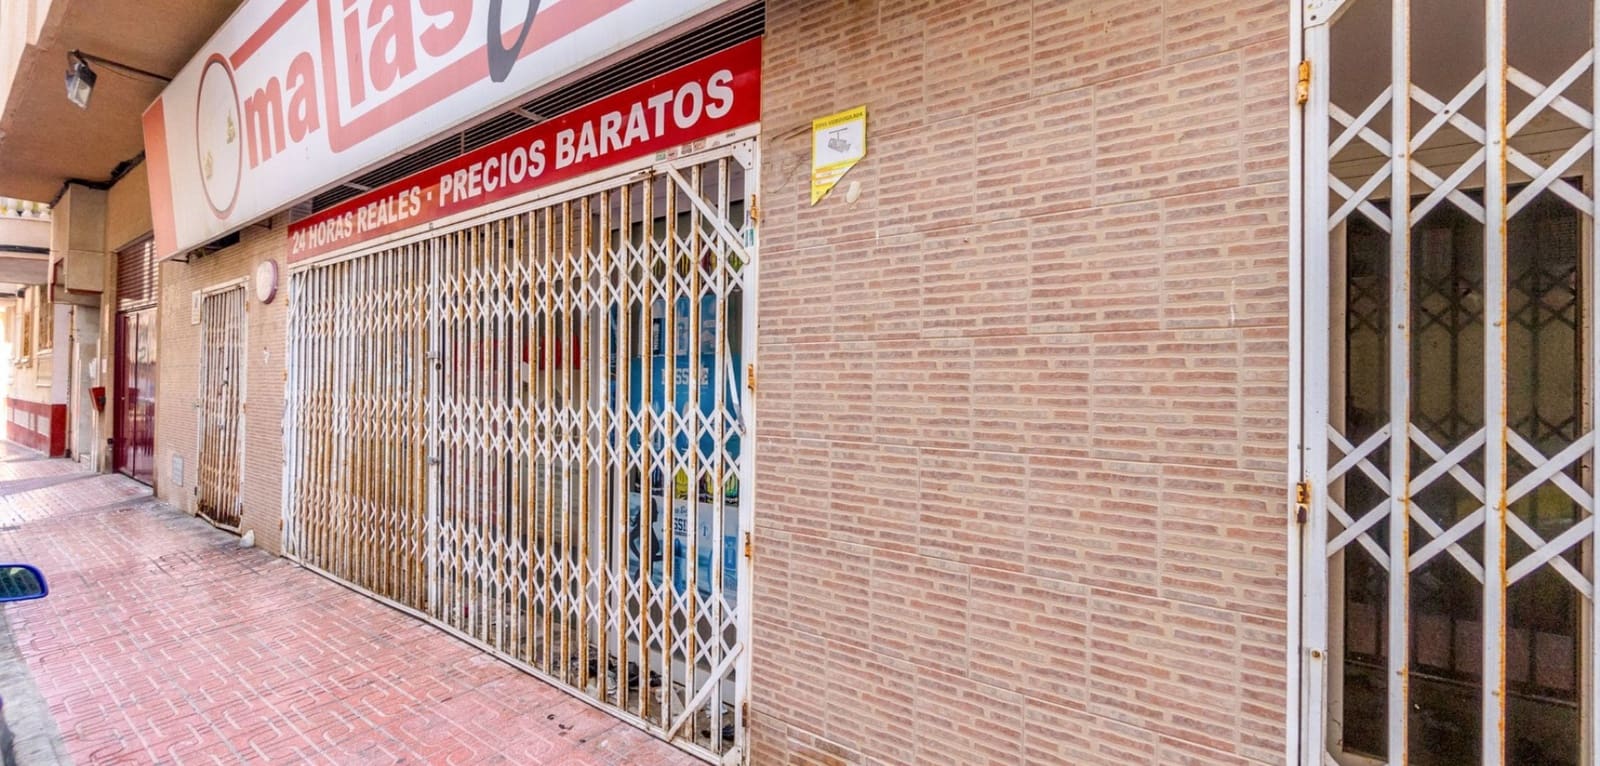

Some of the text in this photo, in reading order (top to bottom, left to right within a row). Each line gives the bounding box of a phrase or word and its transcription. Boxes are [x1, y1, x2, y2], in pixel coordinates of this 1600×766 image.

[292, 226, 306, 254] 24
[308, 211, 353, 249] HORAS
[357, 186, 421, 233] REALES
[439, 139, 546, 207] PRECIOS
[555, 69, 734, 169] BARATOS
